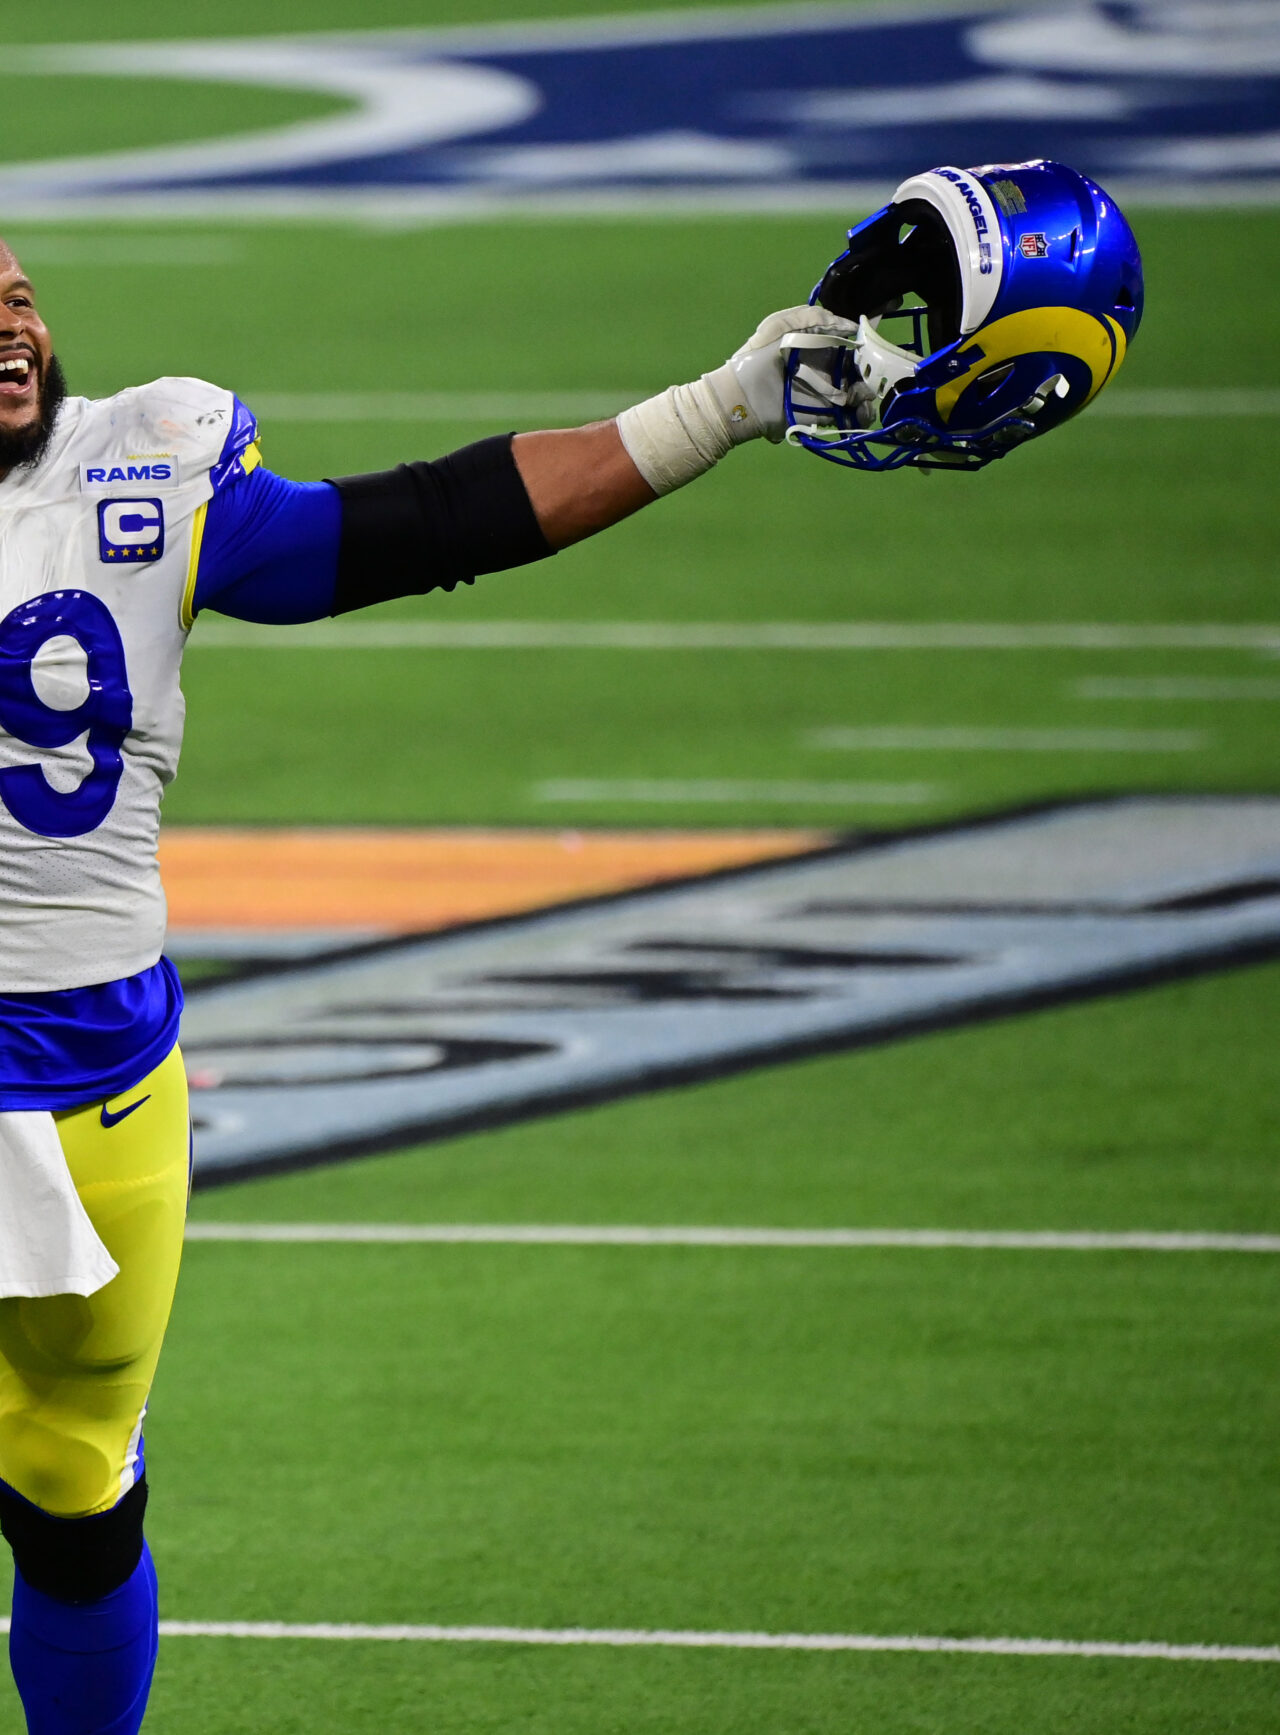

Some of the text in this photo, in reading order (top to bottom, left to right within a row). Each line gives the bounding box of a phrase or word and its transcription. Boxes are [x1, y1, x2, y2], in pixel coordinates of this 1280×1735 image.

[955, 183, 993, 275] ANGELES
[1022, 236, 1037, 256] NFL
[86, 464, 172, 483] RAMS
[103, 501, 161, 546] C
